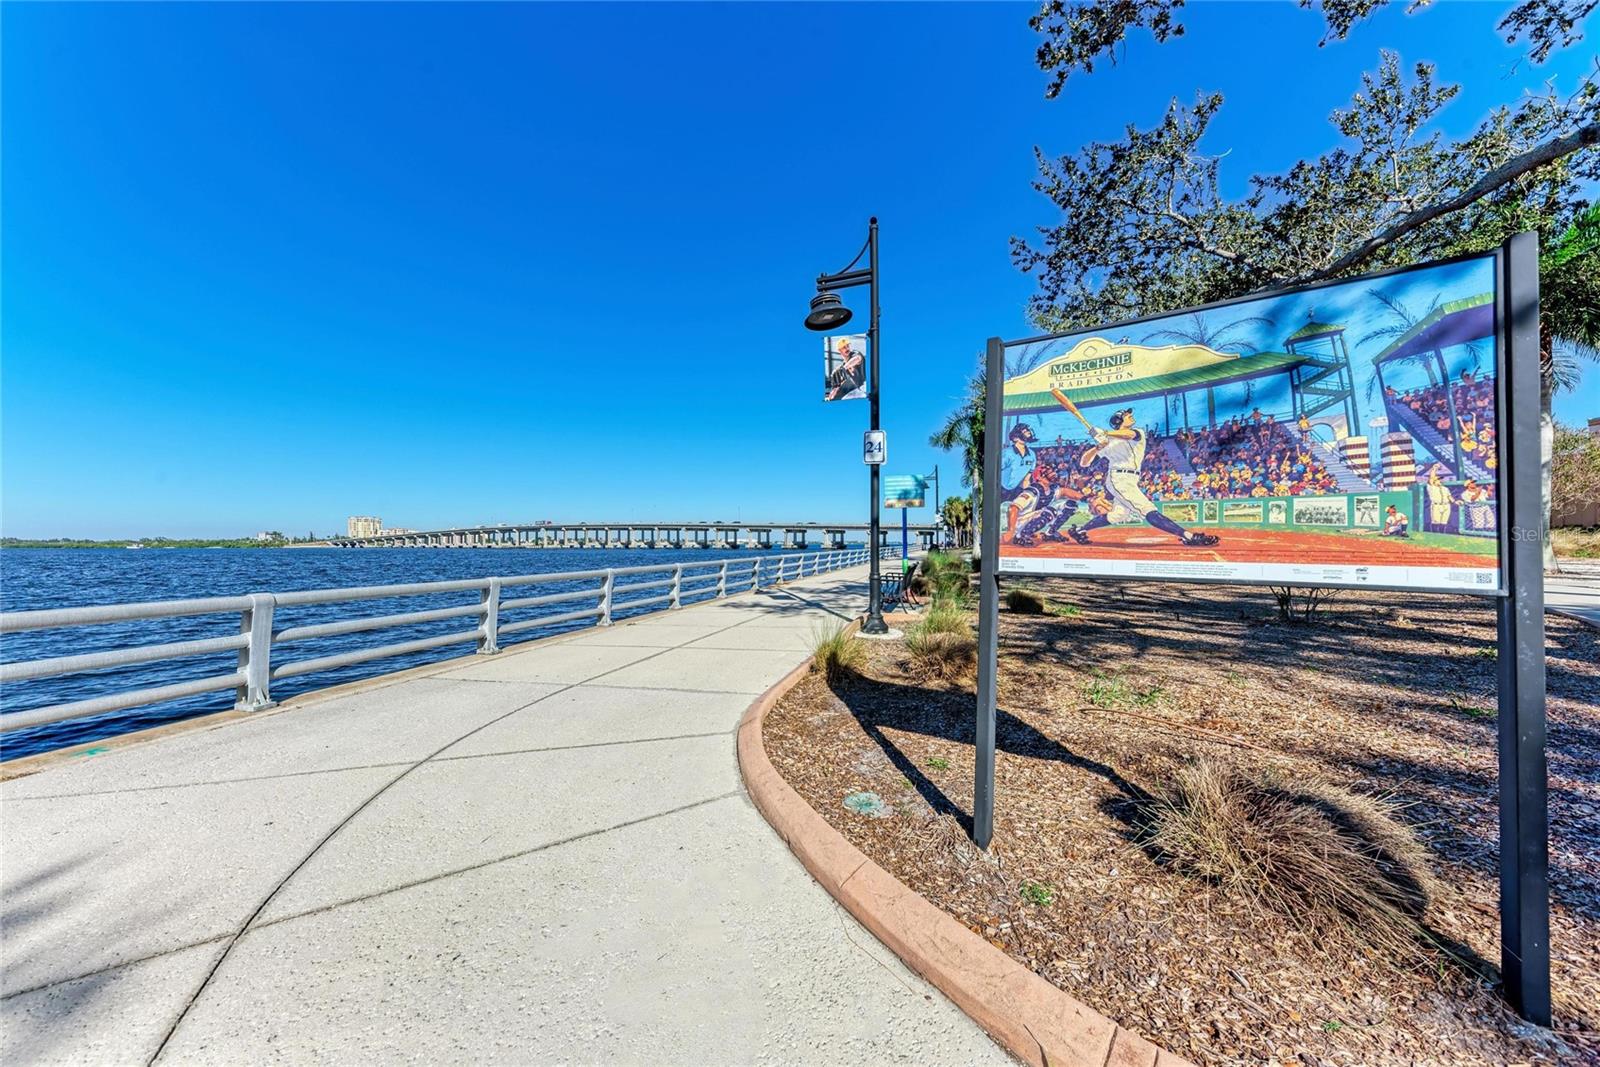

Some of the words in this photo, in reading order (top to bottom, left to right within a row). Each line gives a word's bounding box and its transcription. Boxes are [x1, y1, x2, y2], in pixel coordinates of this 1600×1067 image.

[1052, 354, 1130, 374] McKECHNIE
[1049, 372, 1133, 388] BRADENTON
[866, 441, 882, 453] 24
